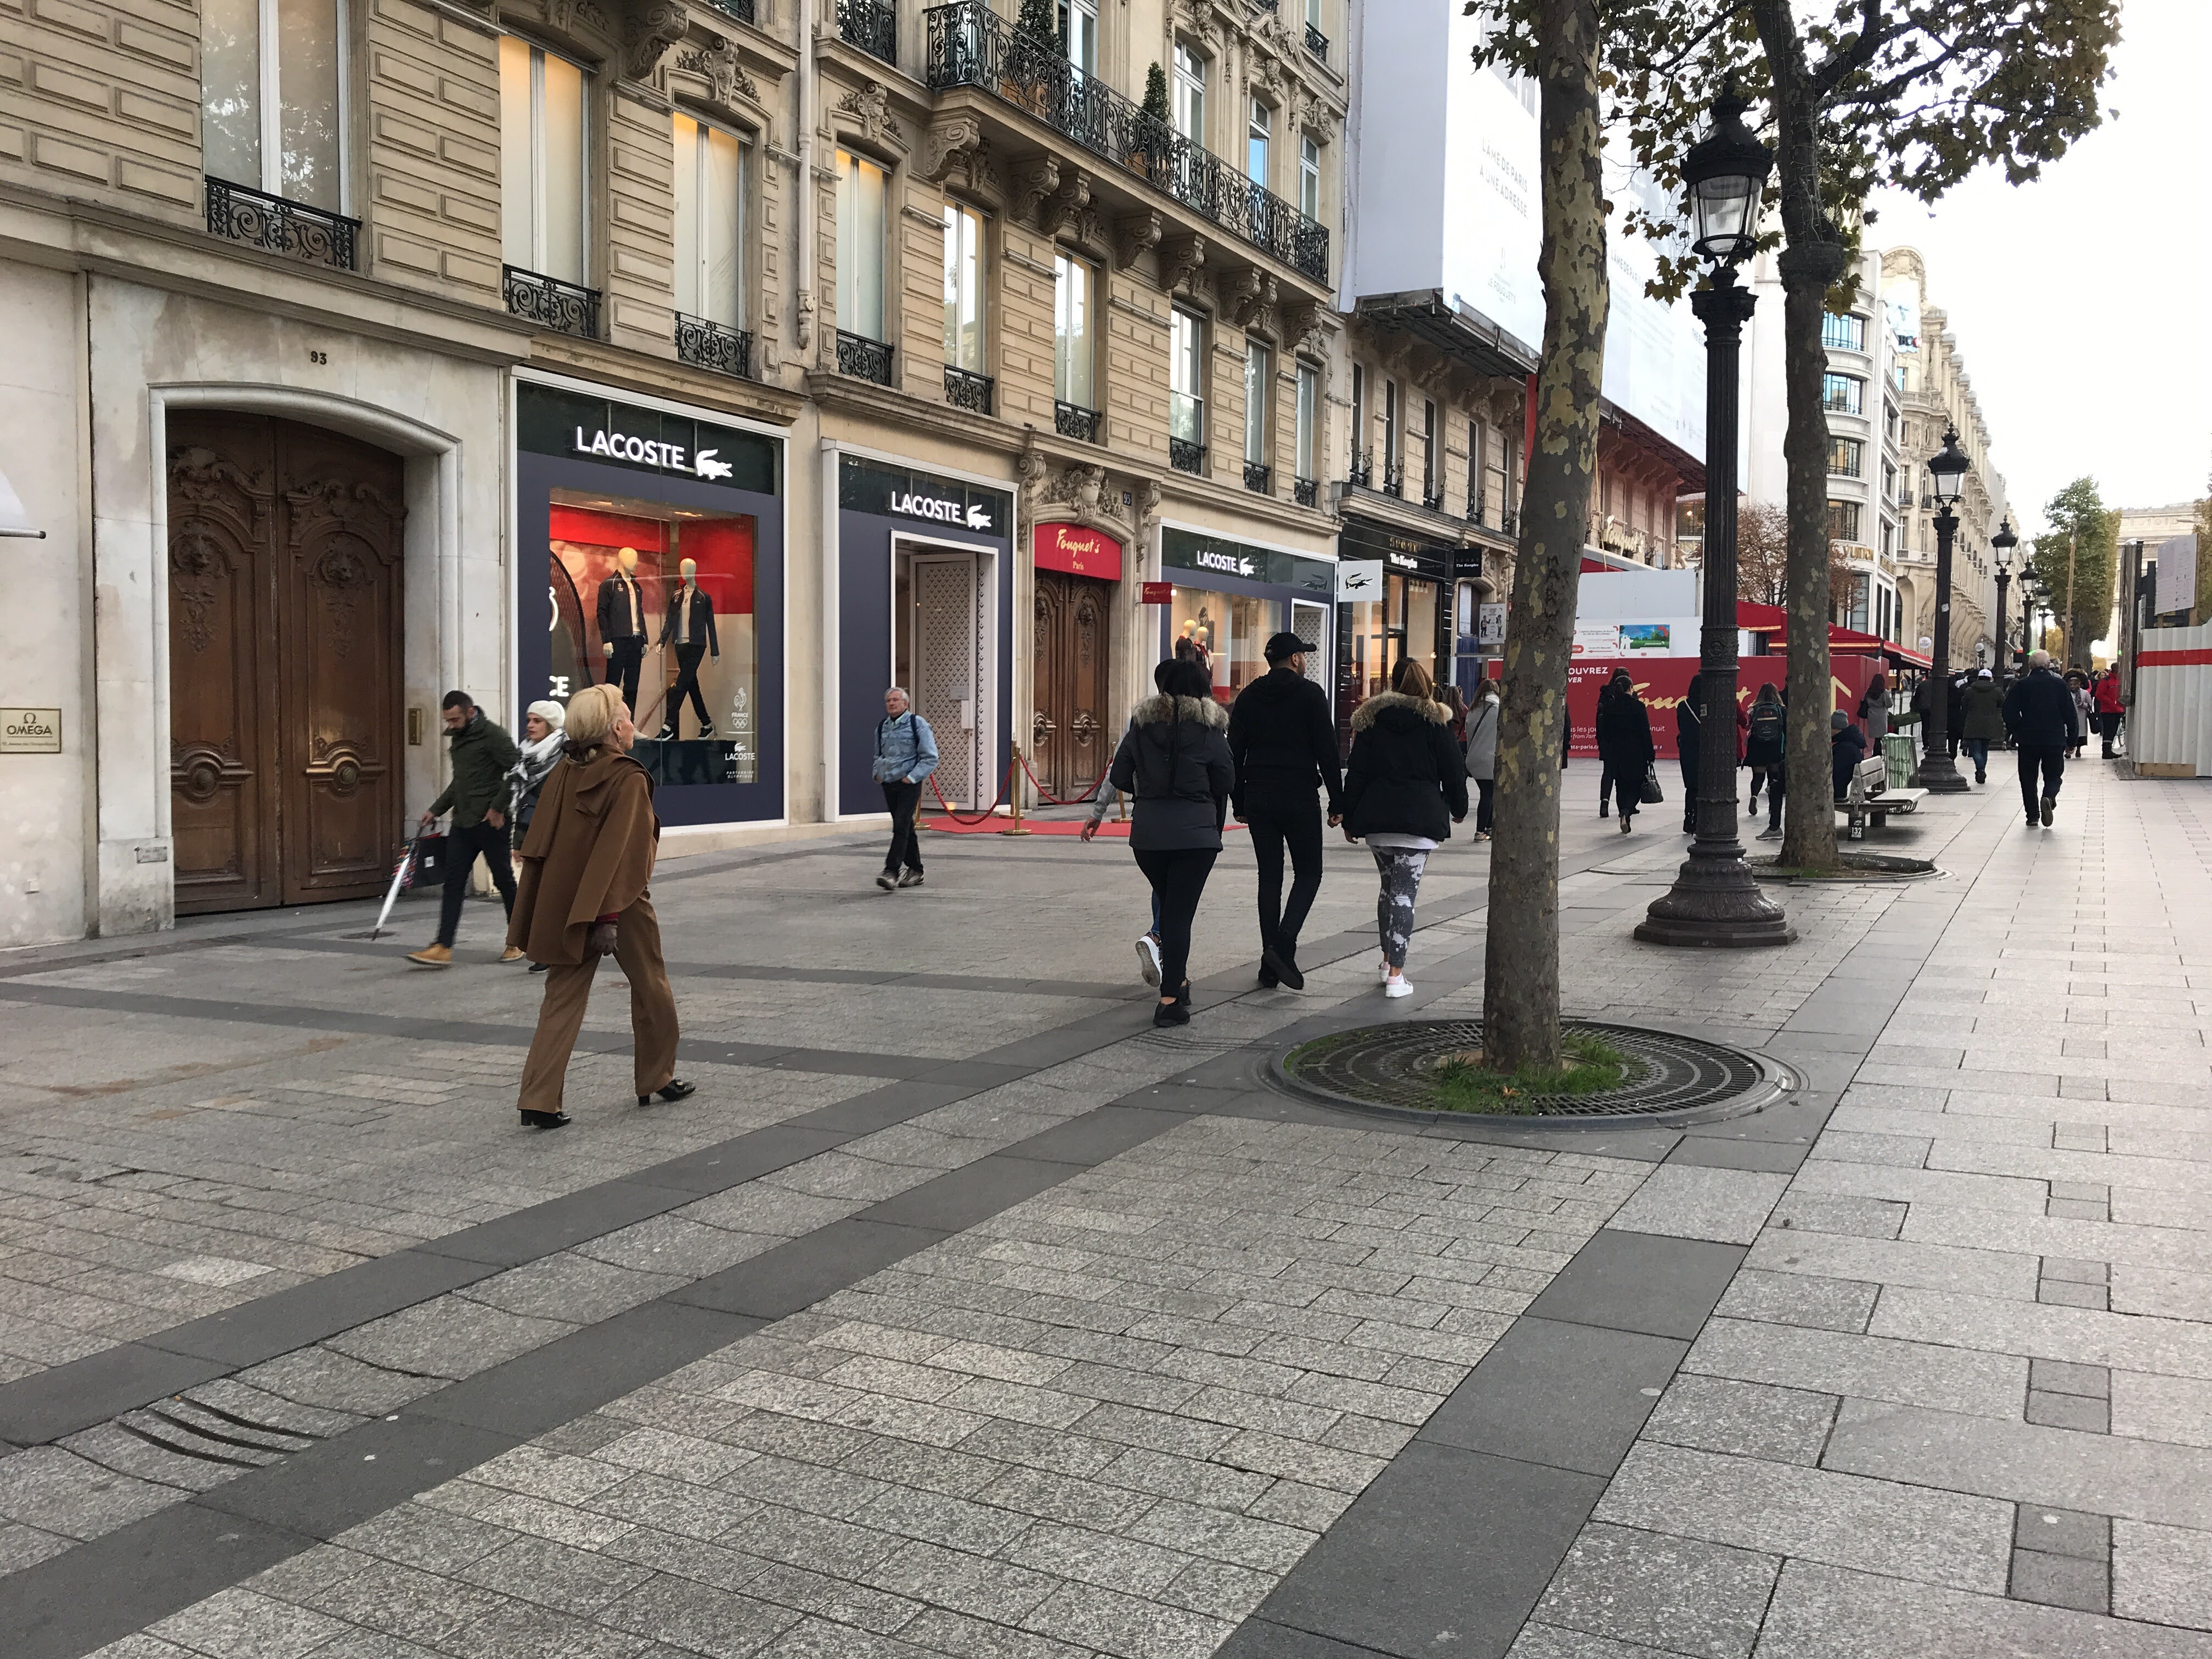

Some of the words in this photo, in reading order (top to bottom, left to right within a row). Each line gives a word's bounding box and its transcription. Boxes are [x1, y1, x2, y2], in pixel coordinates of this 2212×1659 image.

[1486, 169, 1499, 191] UNE
[1502, 157, 1510, 176] DE
[1511, 166, 1528, 193] PARIS
[311, 351, 327, 365] 93
[577, 426, 685, 470] LACOSTE
[891, 490, 961, 522] LACOSTE
[1124, 492, 1131, 505] 95
[1056, 528, 1101, 558] Fouquet's
[1390, 537, 1418, 554] SPORT
[1073, 561, 1084, 571] Paris
[1197, 550, 1237, 572] LACOSTE
[1568, 667, 1609, 675] OUVREZ
[7, 725, 53, 735] OMEGA
[725, 753, 755, 761] LACOSTE
